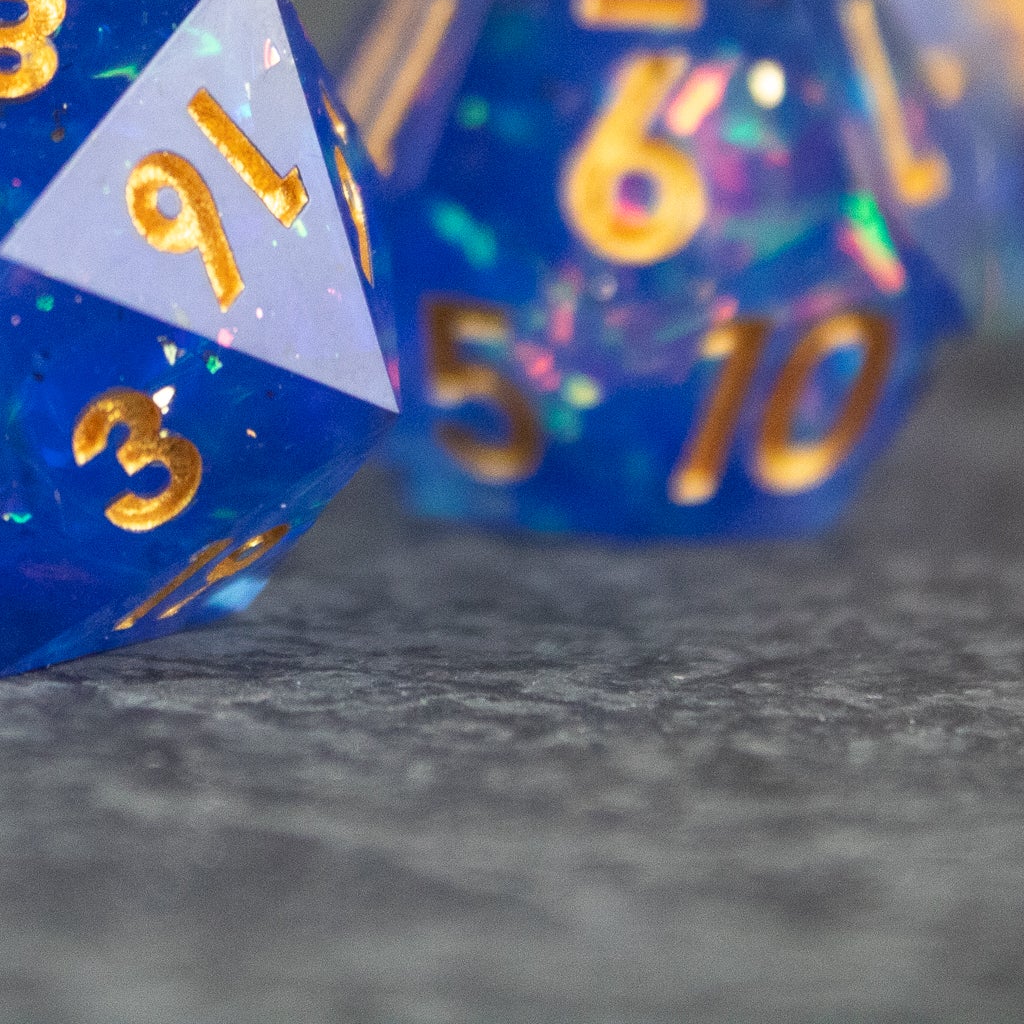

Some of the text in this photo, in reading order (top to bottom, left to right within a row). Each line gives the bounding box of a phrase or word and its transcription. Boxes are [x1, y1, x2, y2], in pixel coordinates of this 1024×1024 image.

[73, 388, 204, 532] 3
[421, 294, 542, 483] 5
[671, 308, 894, 504] 10
